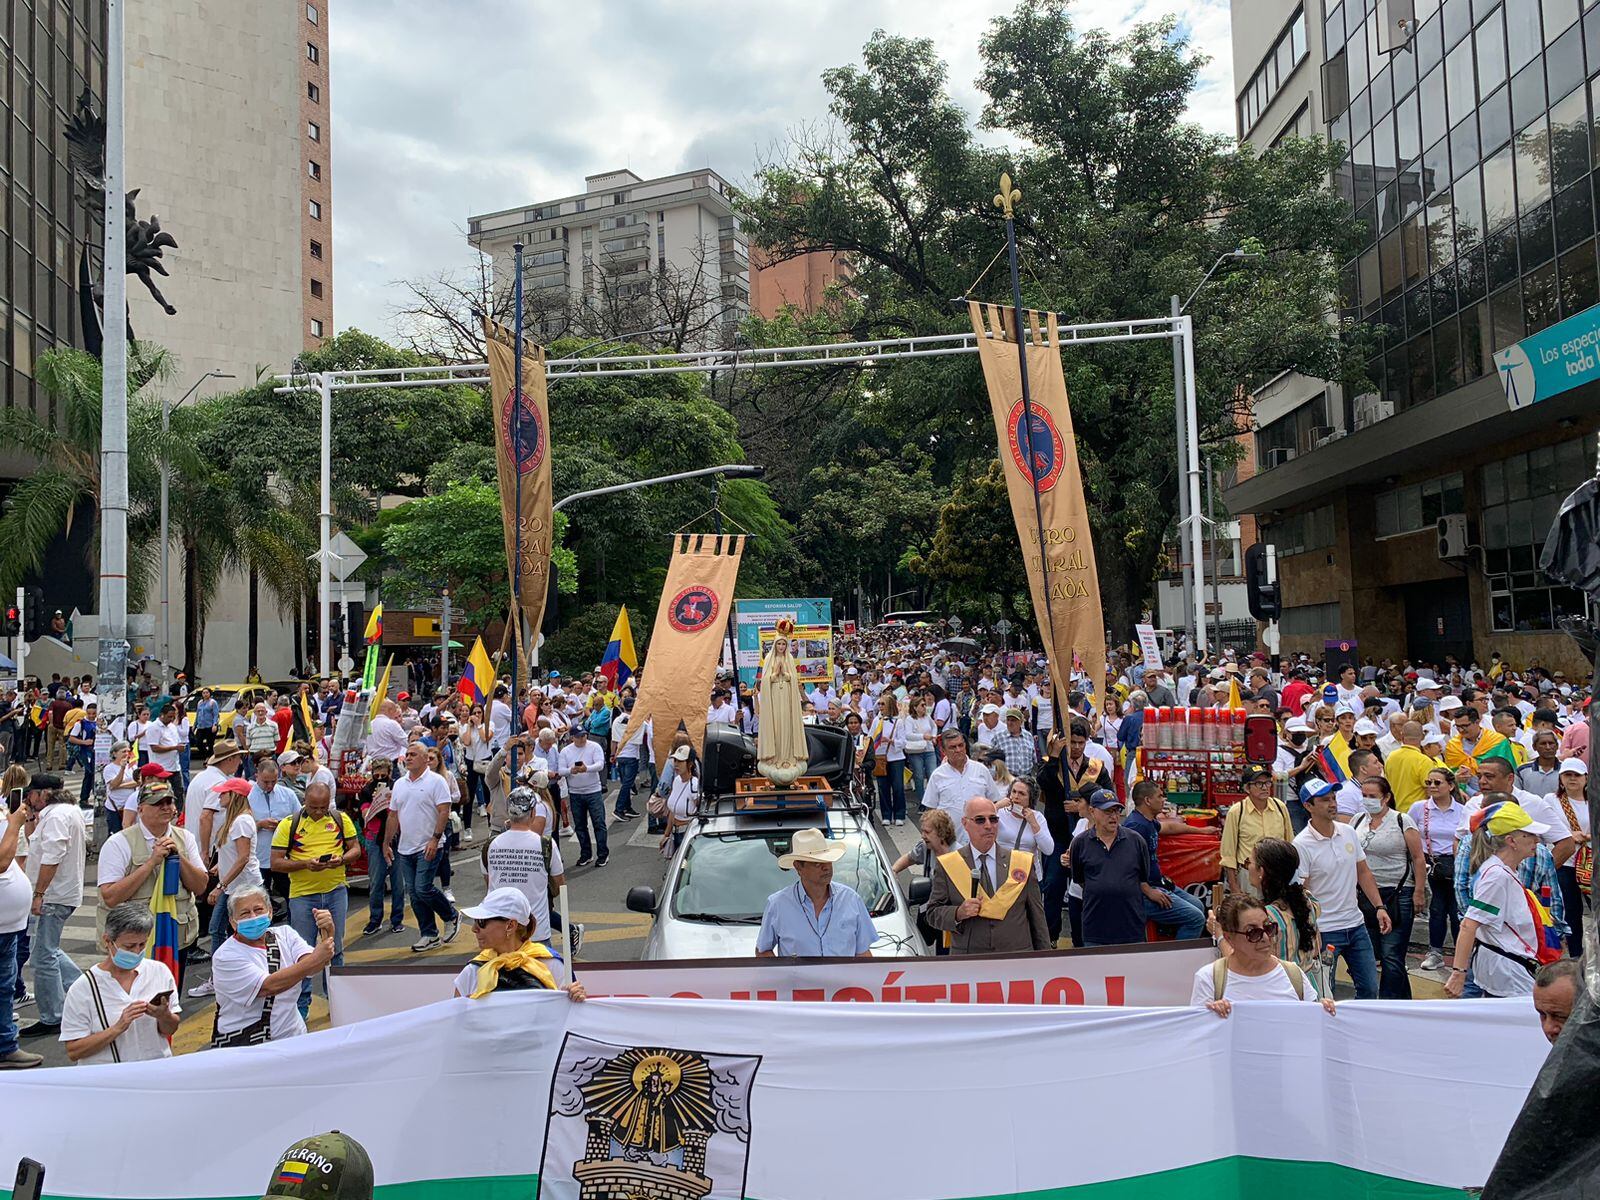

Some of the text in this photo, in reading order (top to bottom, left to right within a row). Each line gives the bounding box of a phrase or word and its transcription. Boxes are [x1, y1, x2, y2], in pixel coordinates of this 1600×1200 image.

[1540, 348, 1558, 364] Los
[1565, 350, 1595, 377] toda
[1184, 882, 1213, 907] Pi
